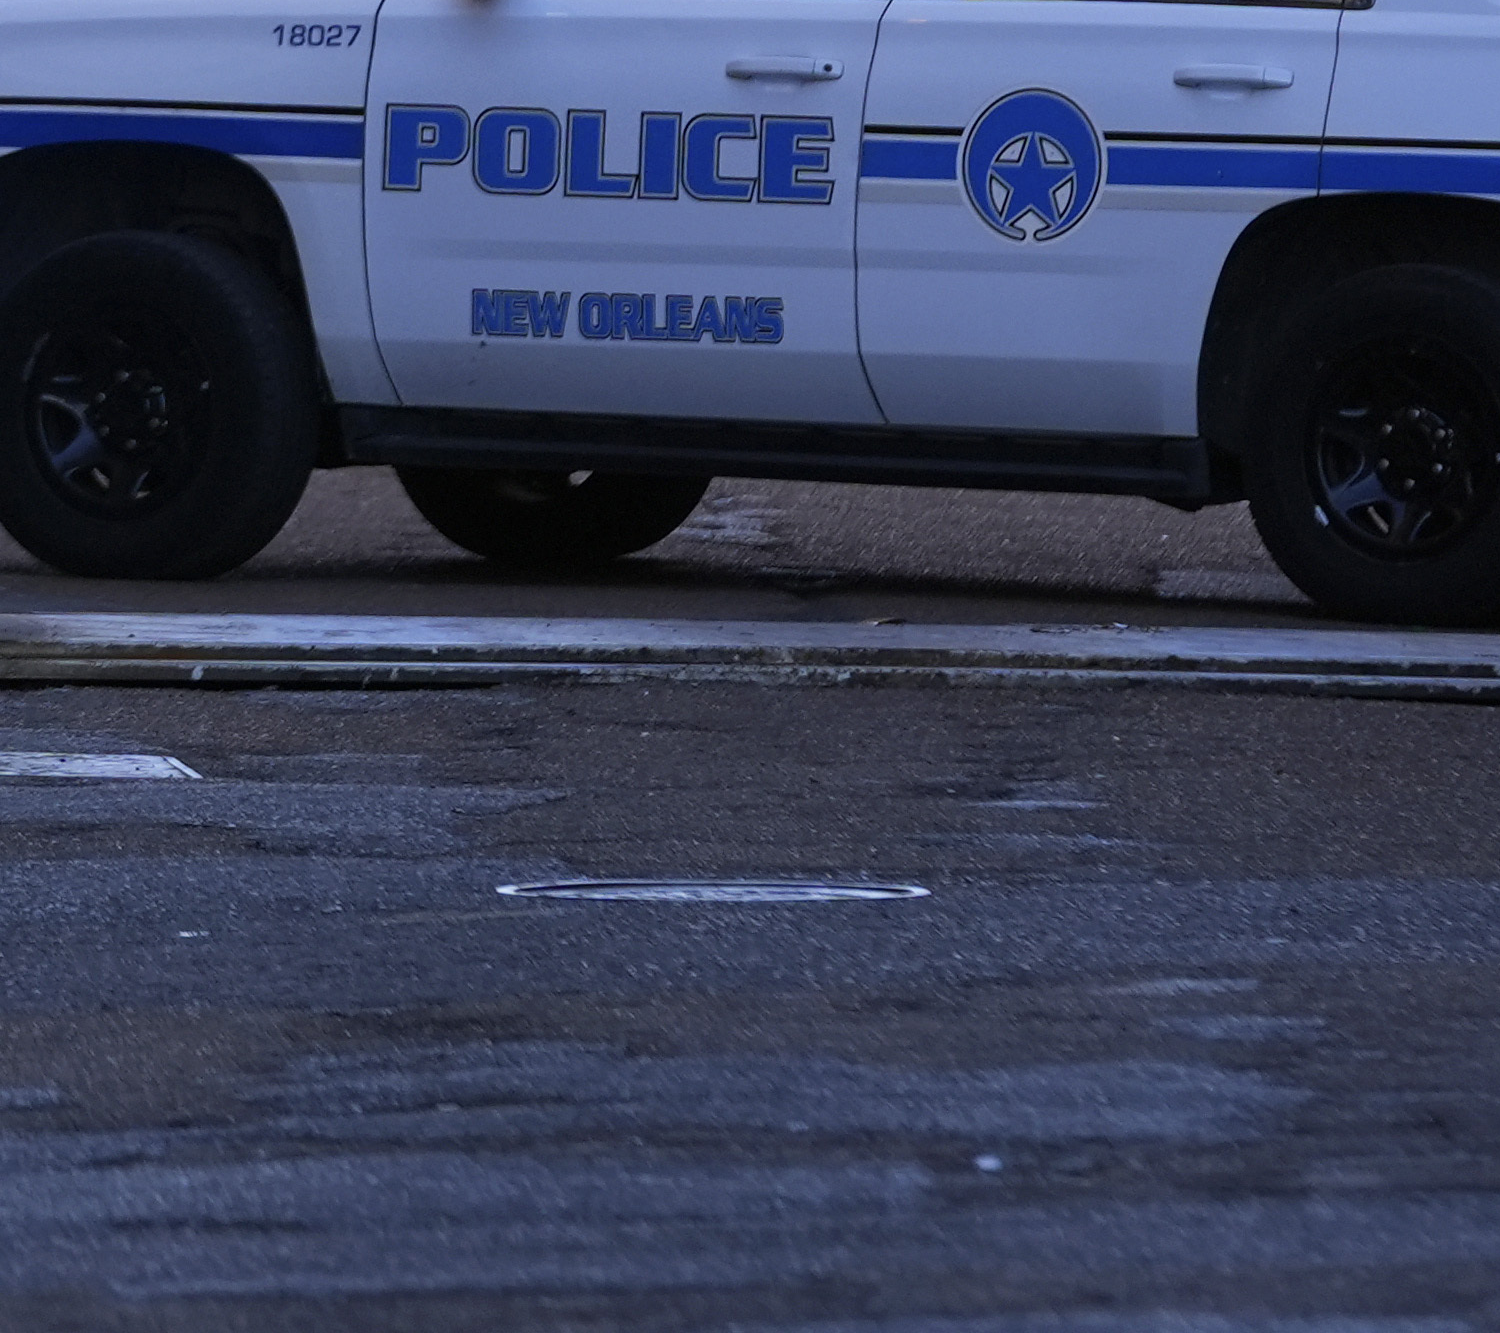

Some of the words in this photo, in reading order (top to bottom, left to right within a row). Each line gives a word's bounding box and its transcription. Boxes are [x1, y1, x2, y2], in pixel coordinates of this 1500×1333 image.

[272, 23, 362, 47] 18027
[382, 102, 835, 204] POLICE
[471, 288, 571, 338] NEW
[579, 291, 785, 344] ORLEANS
